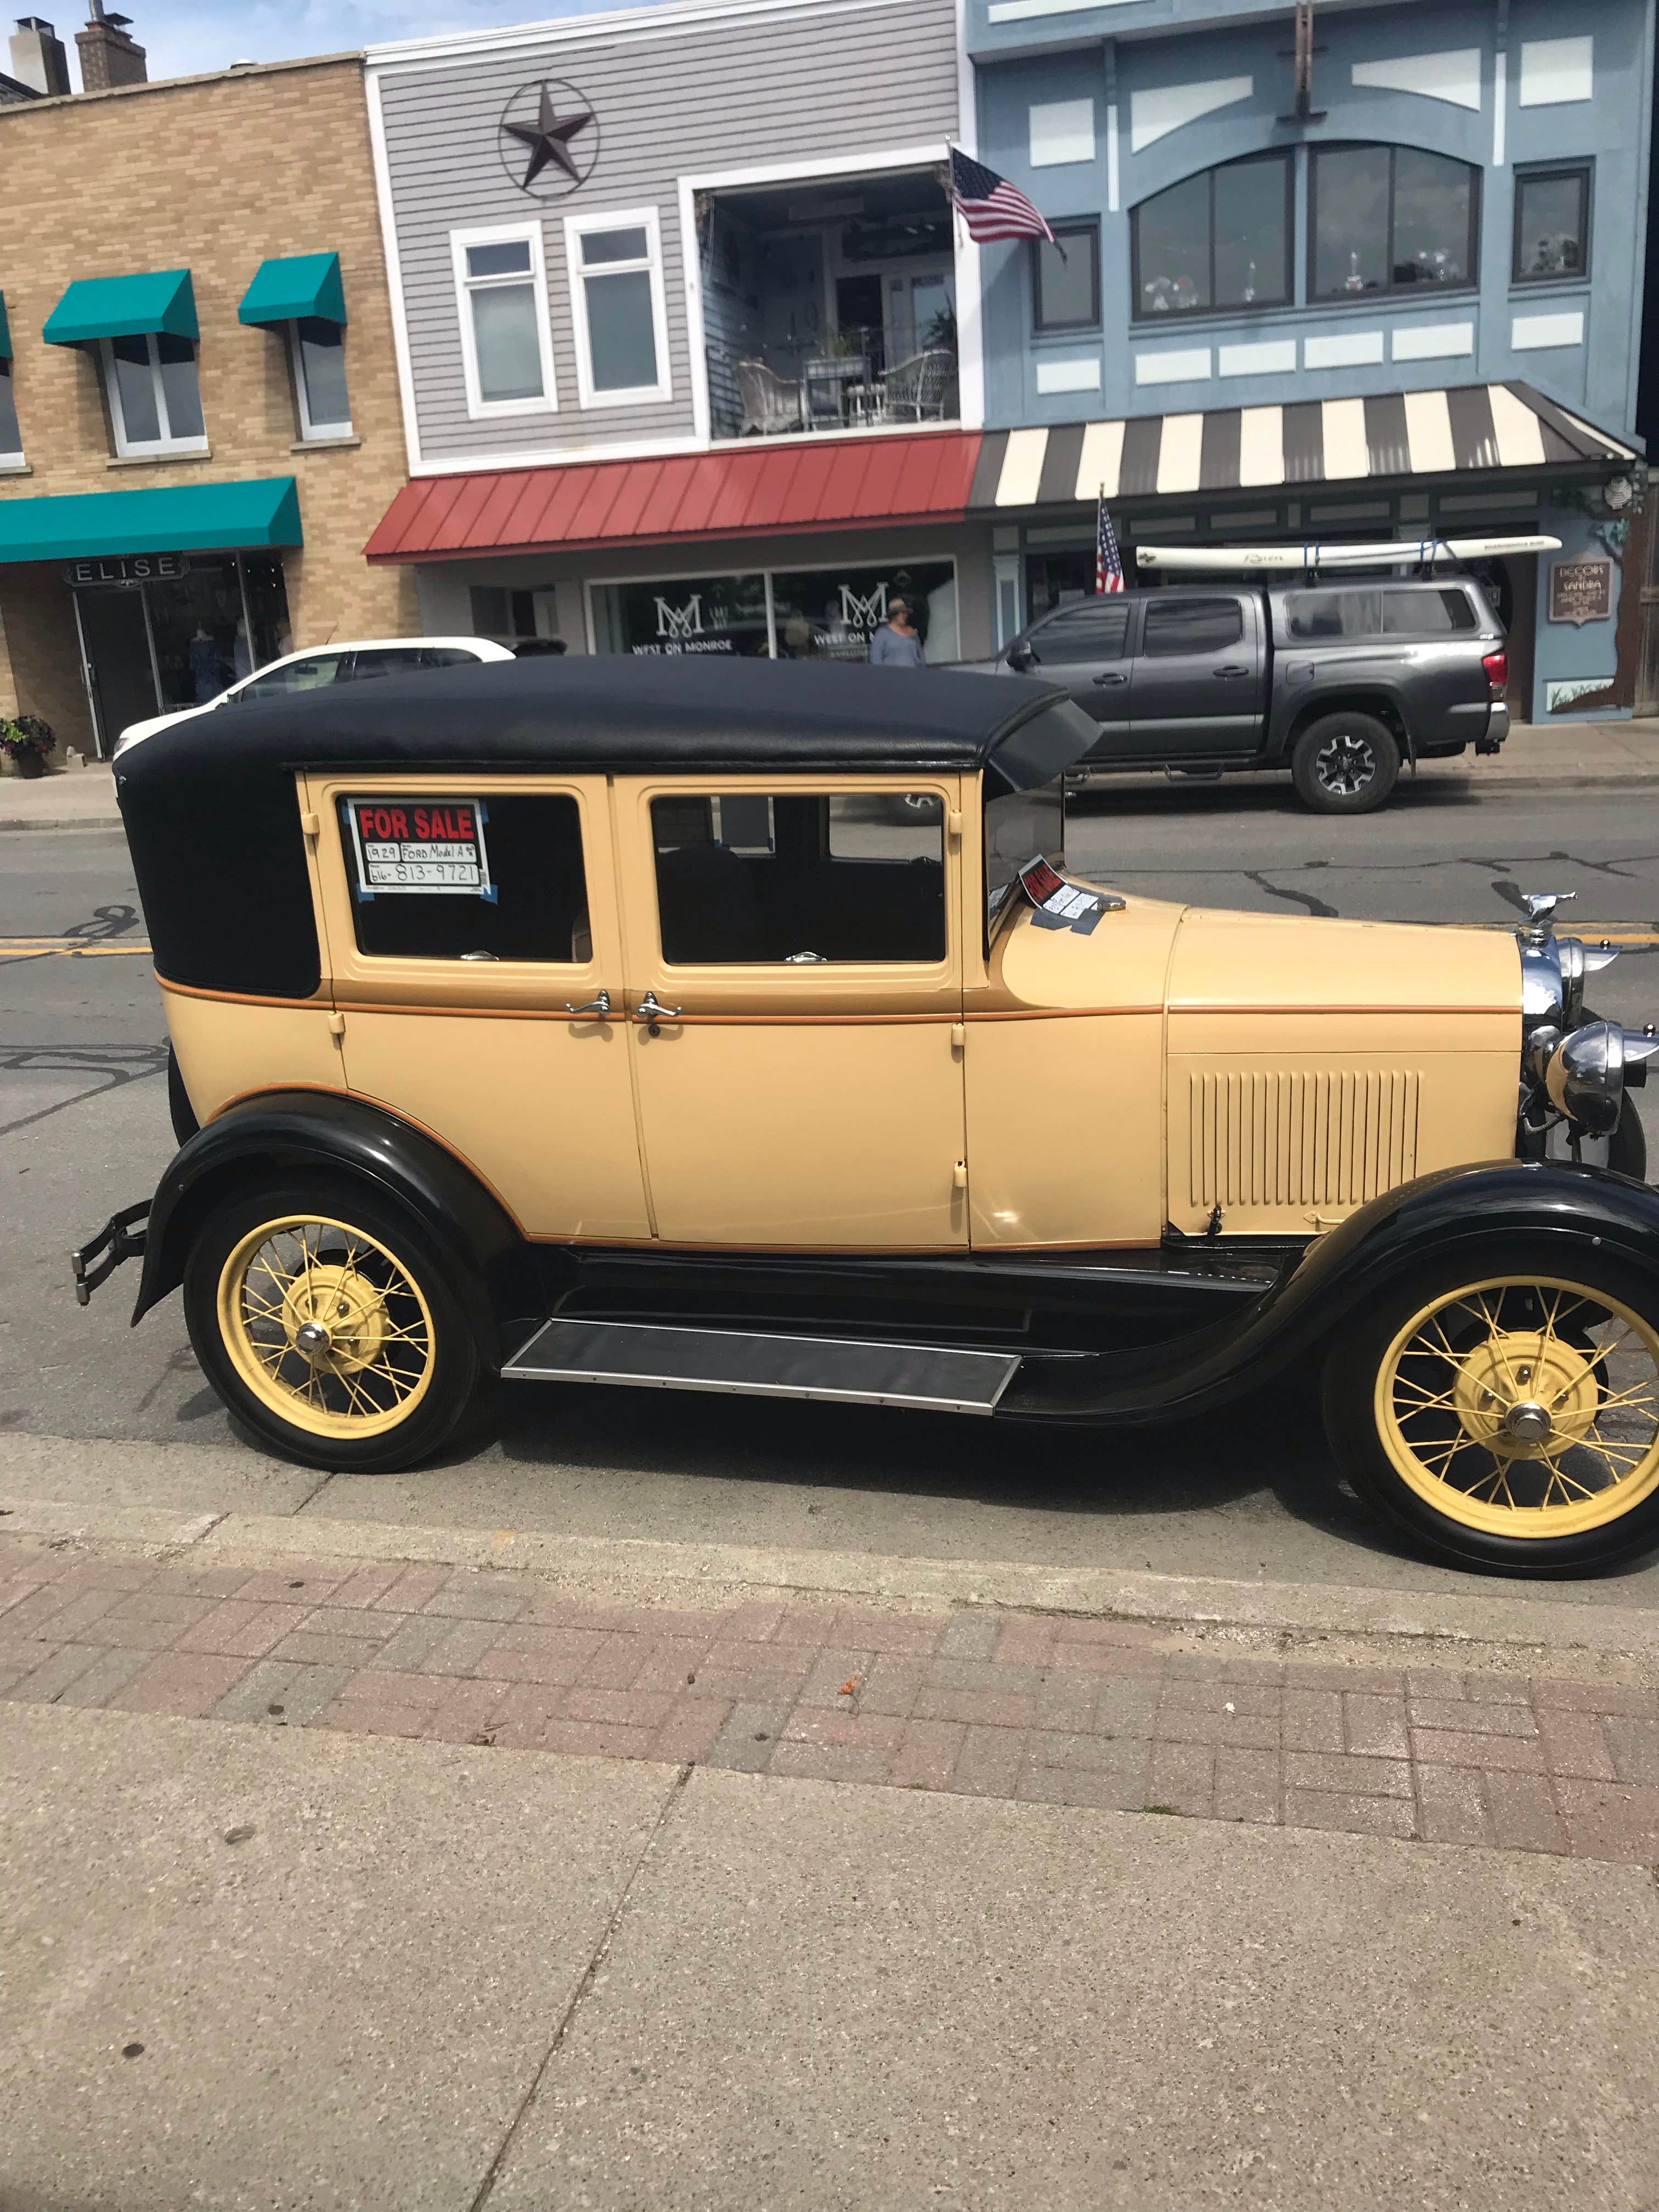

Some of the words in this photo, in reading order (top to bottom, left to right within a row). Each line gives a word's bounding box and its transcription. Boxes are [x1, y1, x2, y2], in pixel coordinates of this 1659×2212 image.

[76, 556, 175, 581] ELISE
[848, 631, 865, 643] ON
[685, 639, 733, 652] MONROE
[359, 808, 409, 839] FOR
[414, 808, 474, 839] SALE
[368, 847, 396, 860] 1929
[403, 848, 427, 860] FORD
[429, 844, 454, 859] Model
[458, 845, 464, 858] A
